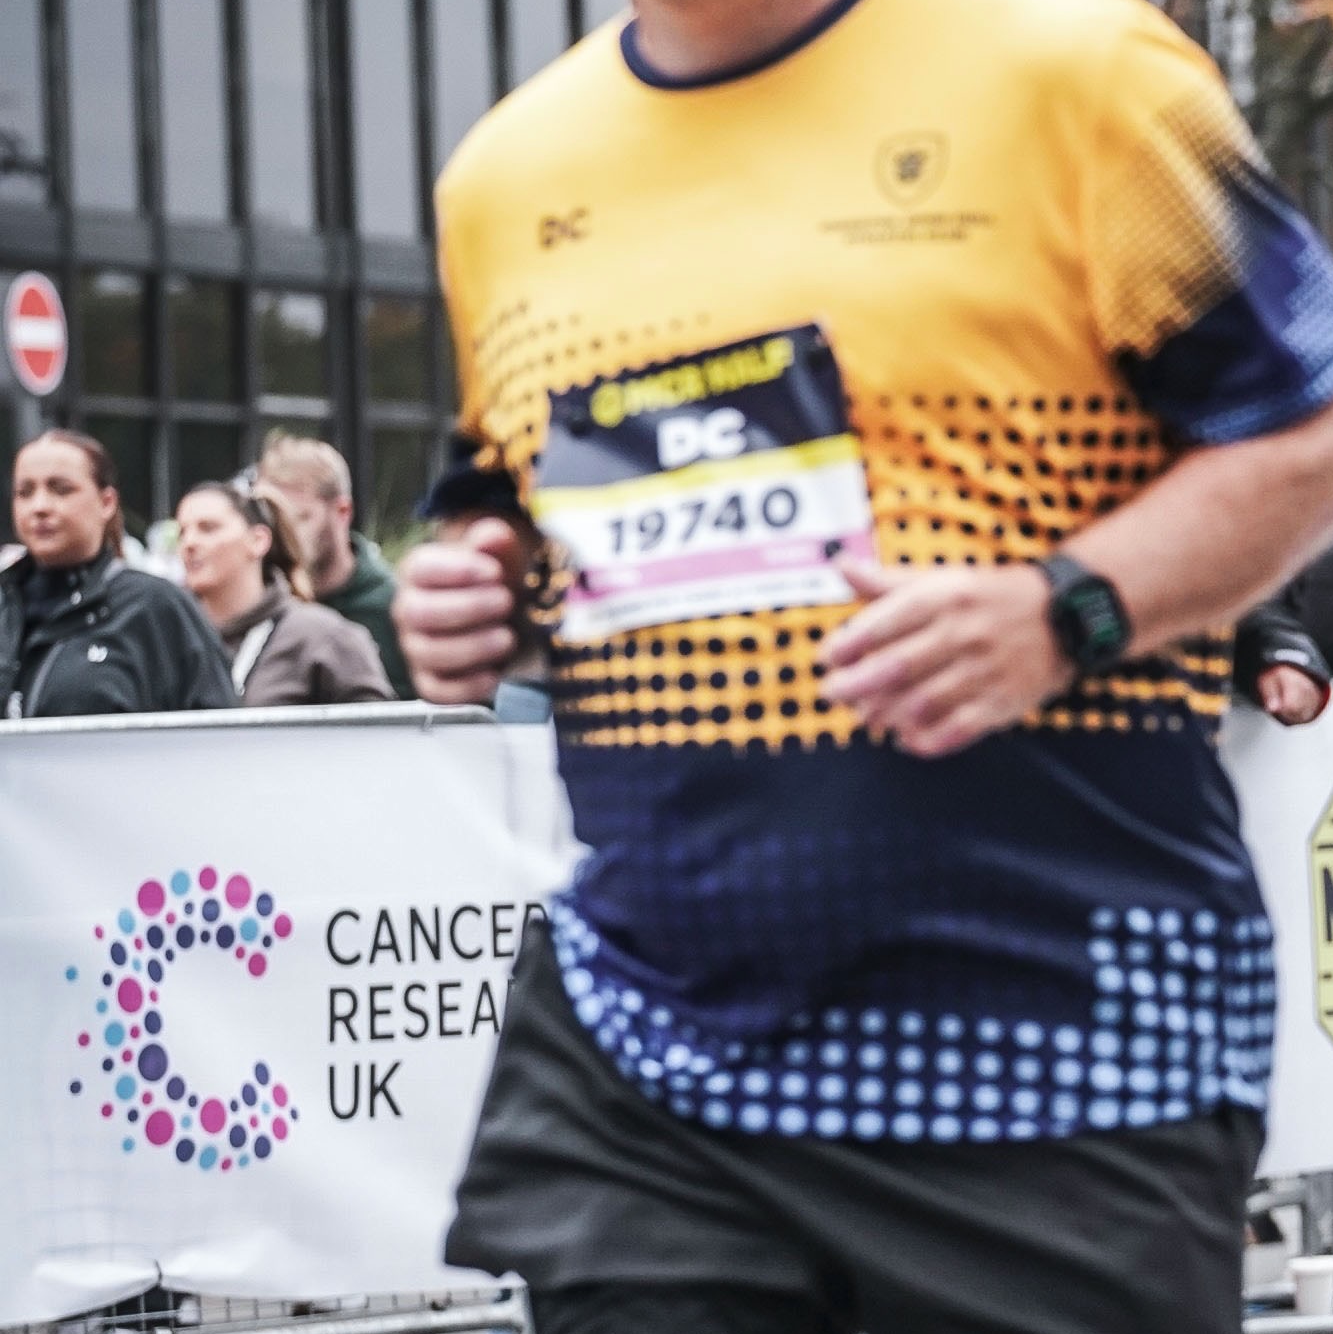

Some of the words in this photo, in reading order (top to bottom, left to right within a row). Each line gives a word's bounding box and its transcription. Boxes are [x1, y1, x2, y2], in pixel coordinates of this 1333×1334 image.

[656, 407, 748, 469] DC
[608, 488, 799, 557] 19740
[329, 979, 512, 1043] RESEA
[329, 1062, 402, 1120] UK
